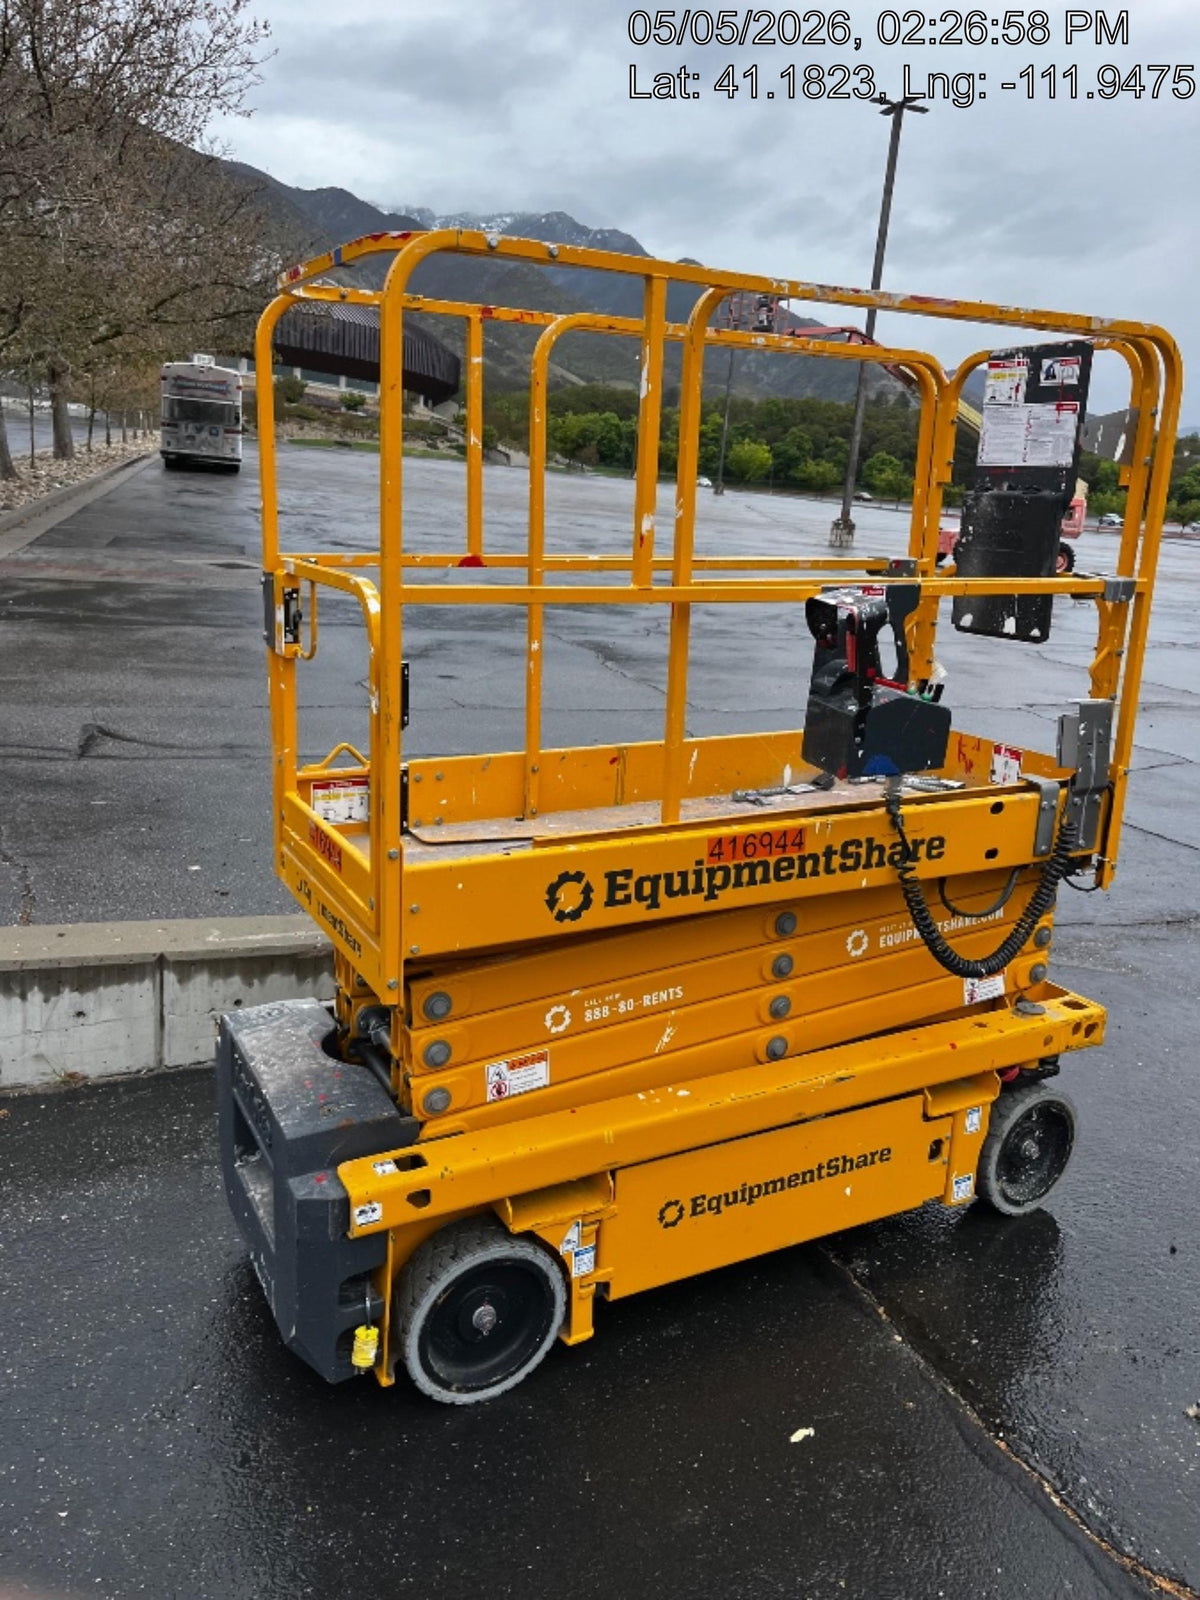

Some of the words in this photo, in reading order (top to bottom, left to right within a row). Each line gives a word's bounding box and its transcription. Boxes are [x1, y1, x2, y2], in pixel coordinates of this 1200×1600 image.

[604, 834, 946, 911] EquipmentShare
[708, 827, 805, 861] 416944
[689, 1146, 893, 1218] EquipmentShare
